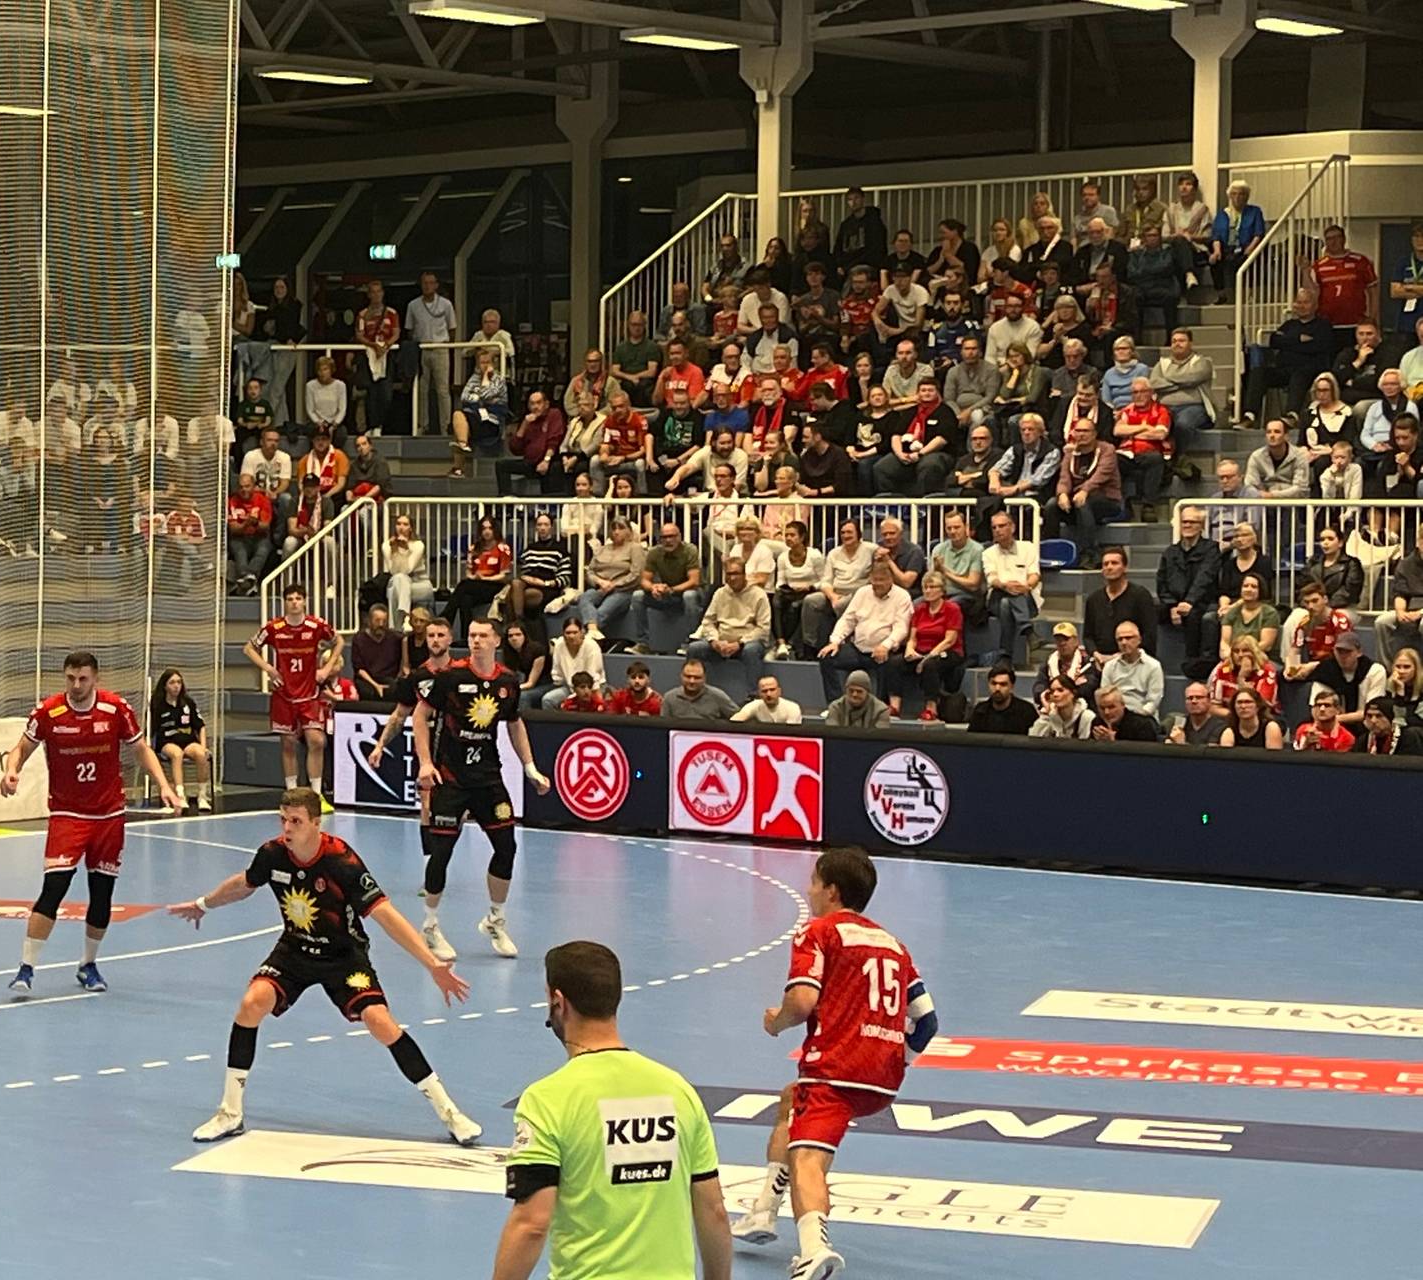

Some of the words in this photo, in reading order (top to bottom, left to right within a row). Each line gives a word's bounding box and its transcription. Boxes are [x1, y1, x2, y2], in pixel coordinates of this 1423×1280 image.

[290, 658, 302, 672] 21
[465, 747, 481, 765] 24
[692, 752, 735, 772] TUSEM
[77, 762, 97, 782] 22
[692, 796, 732, 816] ESSEN
[862, 958, 900, 1016] 15
[605, 1116, 676, 1145] KÜS
[619, 1165, 667, 1180] kues.de
